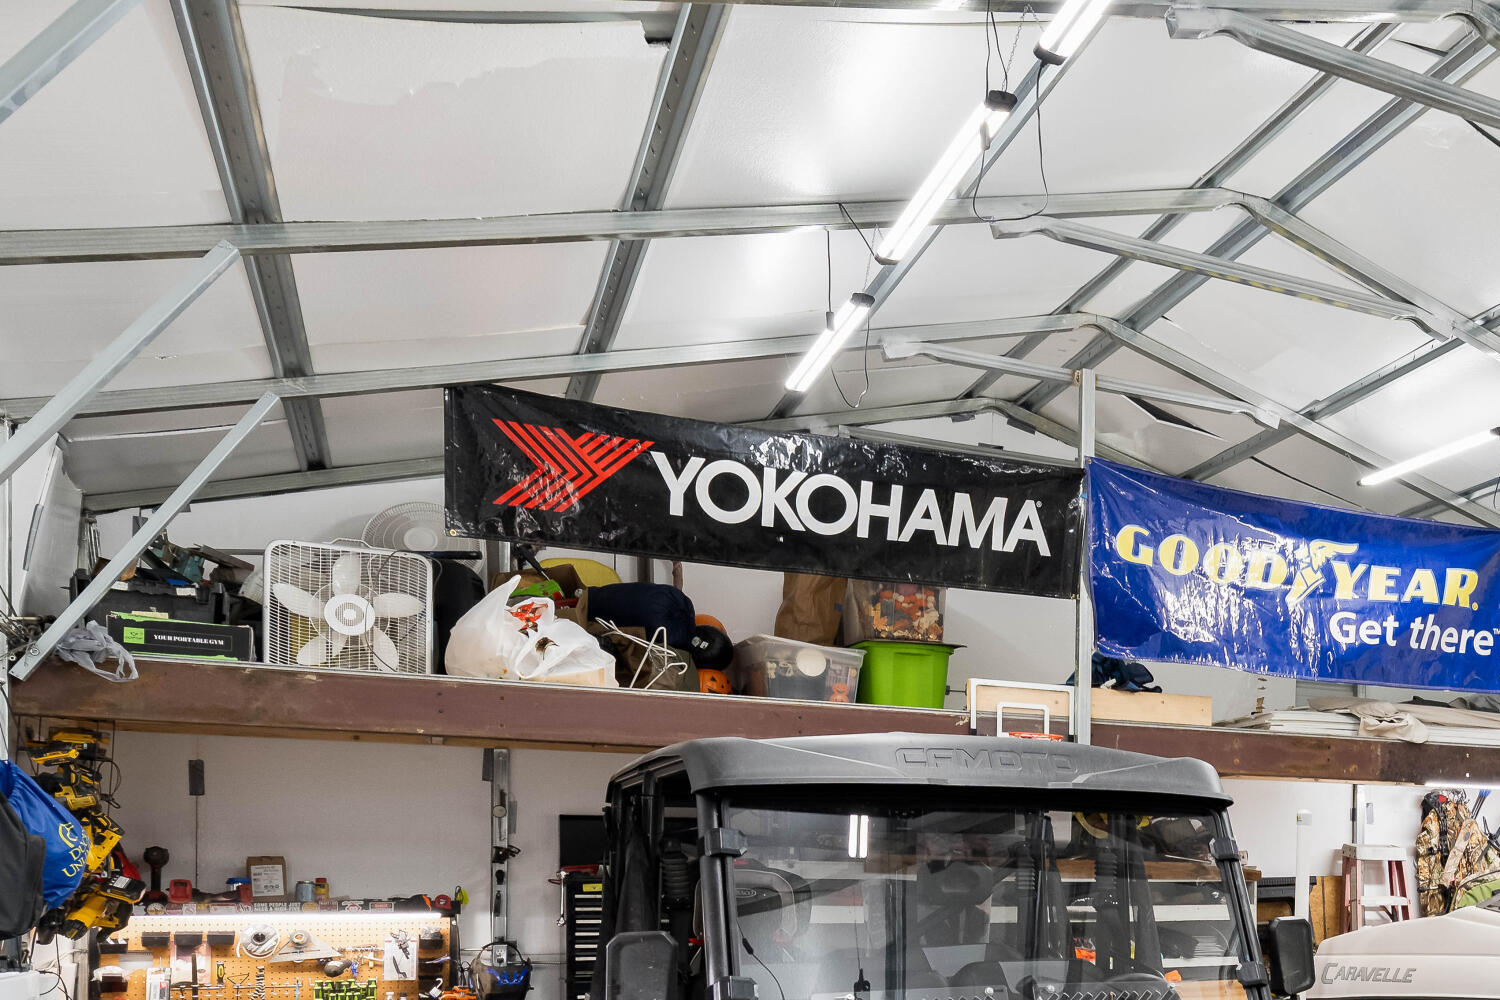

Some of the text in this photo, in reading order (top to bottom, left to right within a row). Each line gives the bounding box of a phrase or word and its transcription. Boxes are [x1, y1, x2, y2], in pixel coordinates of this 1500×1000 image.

[650, 451, 1051, 557] YOKOHAMA
[153, 633, 224, 646] YOUR PORTABLE GYM
[1329, 611, 1494, 656] Get there
[895, 747, 1078, 773] CFMOTO
[1321, 962, 1417, 985] CARAVELLE
